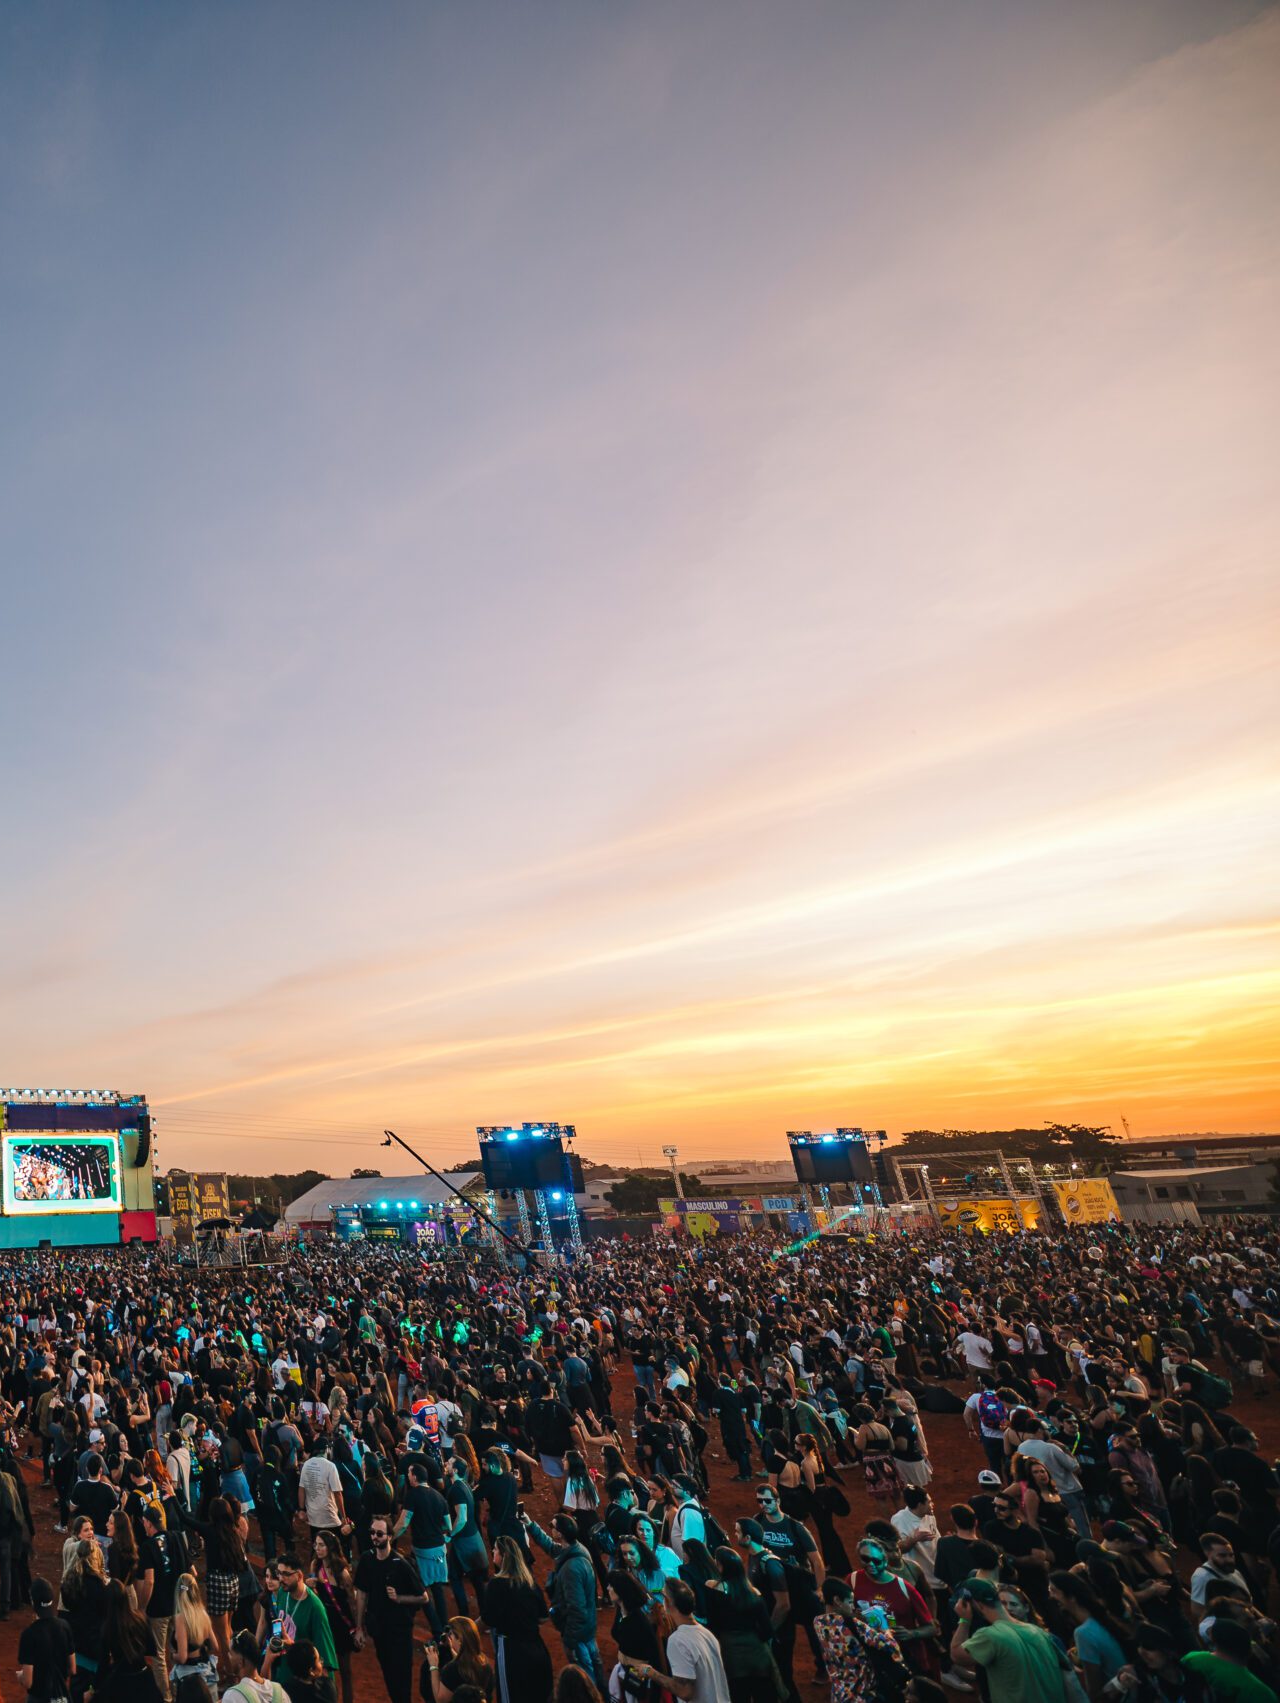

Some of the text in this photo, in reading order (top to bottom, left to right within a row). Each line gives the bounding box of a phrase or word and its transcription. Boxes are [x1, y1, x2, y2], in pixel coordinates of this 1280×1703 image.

[686, 1200, 728, 1211] MASCULINO
[768, 1200, 788, 1210] PCD
[202, 1208, 221, 1220] EISEN
[416, 1226, 436, 1236] JOÃO
